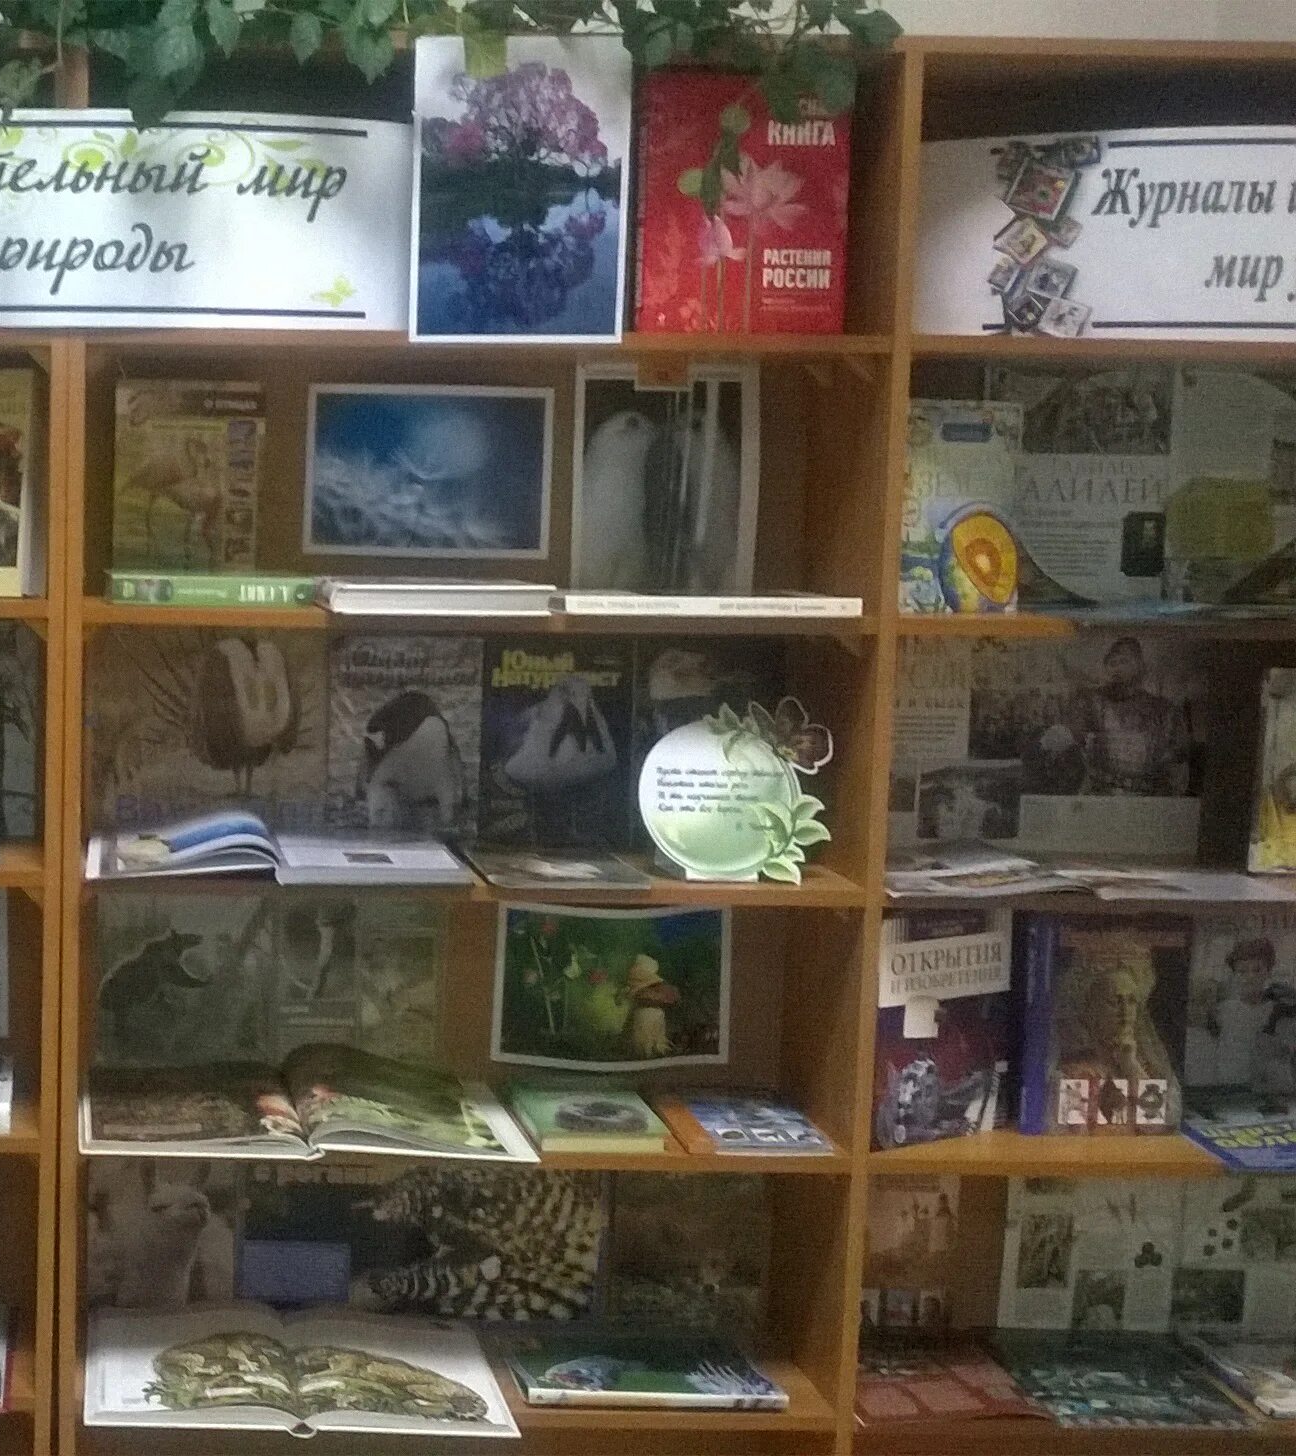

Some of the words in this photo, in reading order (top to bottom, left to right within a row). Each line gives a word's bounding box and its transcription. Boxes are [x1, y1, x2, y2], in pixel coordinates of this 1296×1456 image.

[767, 119, 836, 147] КНИГА
[234, 161, 346, 222] мир
[1091, 166, 1276, 226] Журналы
[763, 246, 832, 265] РАСТЕНИЯ
[762, 266, 831, 289] РОССИИ
[1204, 252, 1284, 300] мир
[502, 649, 575, 671] Юный
[891, 941, 1003, 976] ОТКРЫТИЯ
